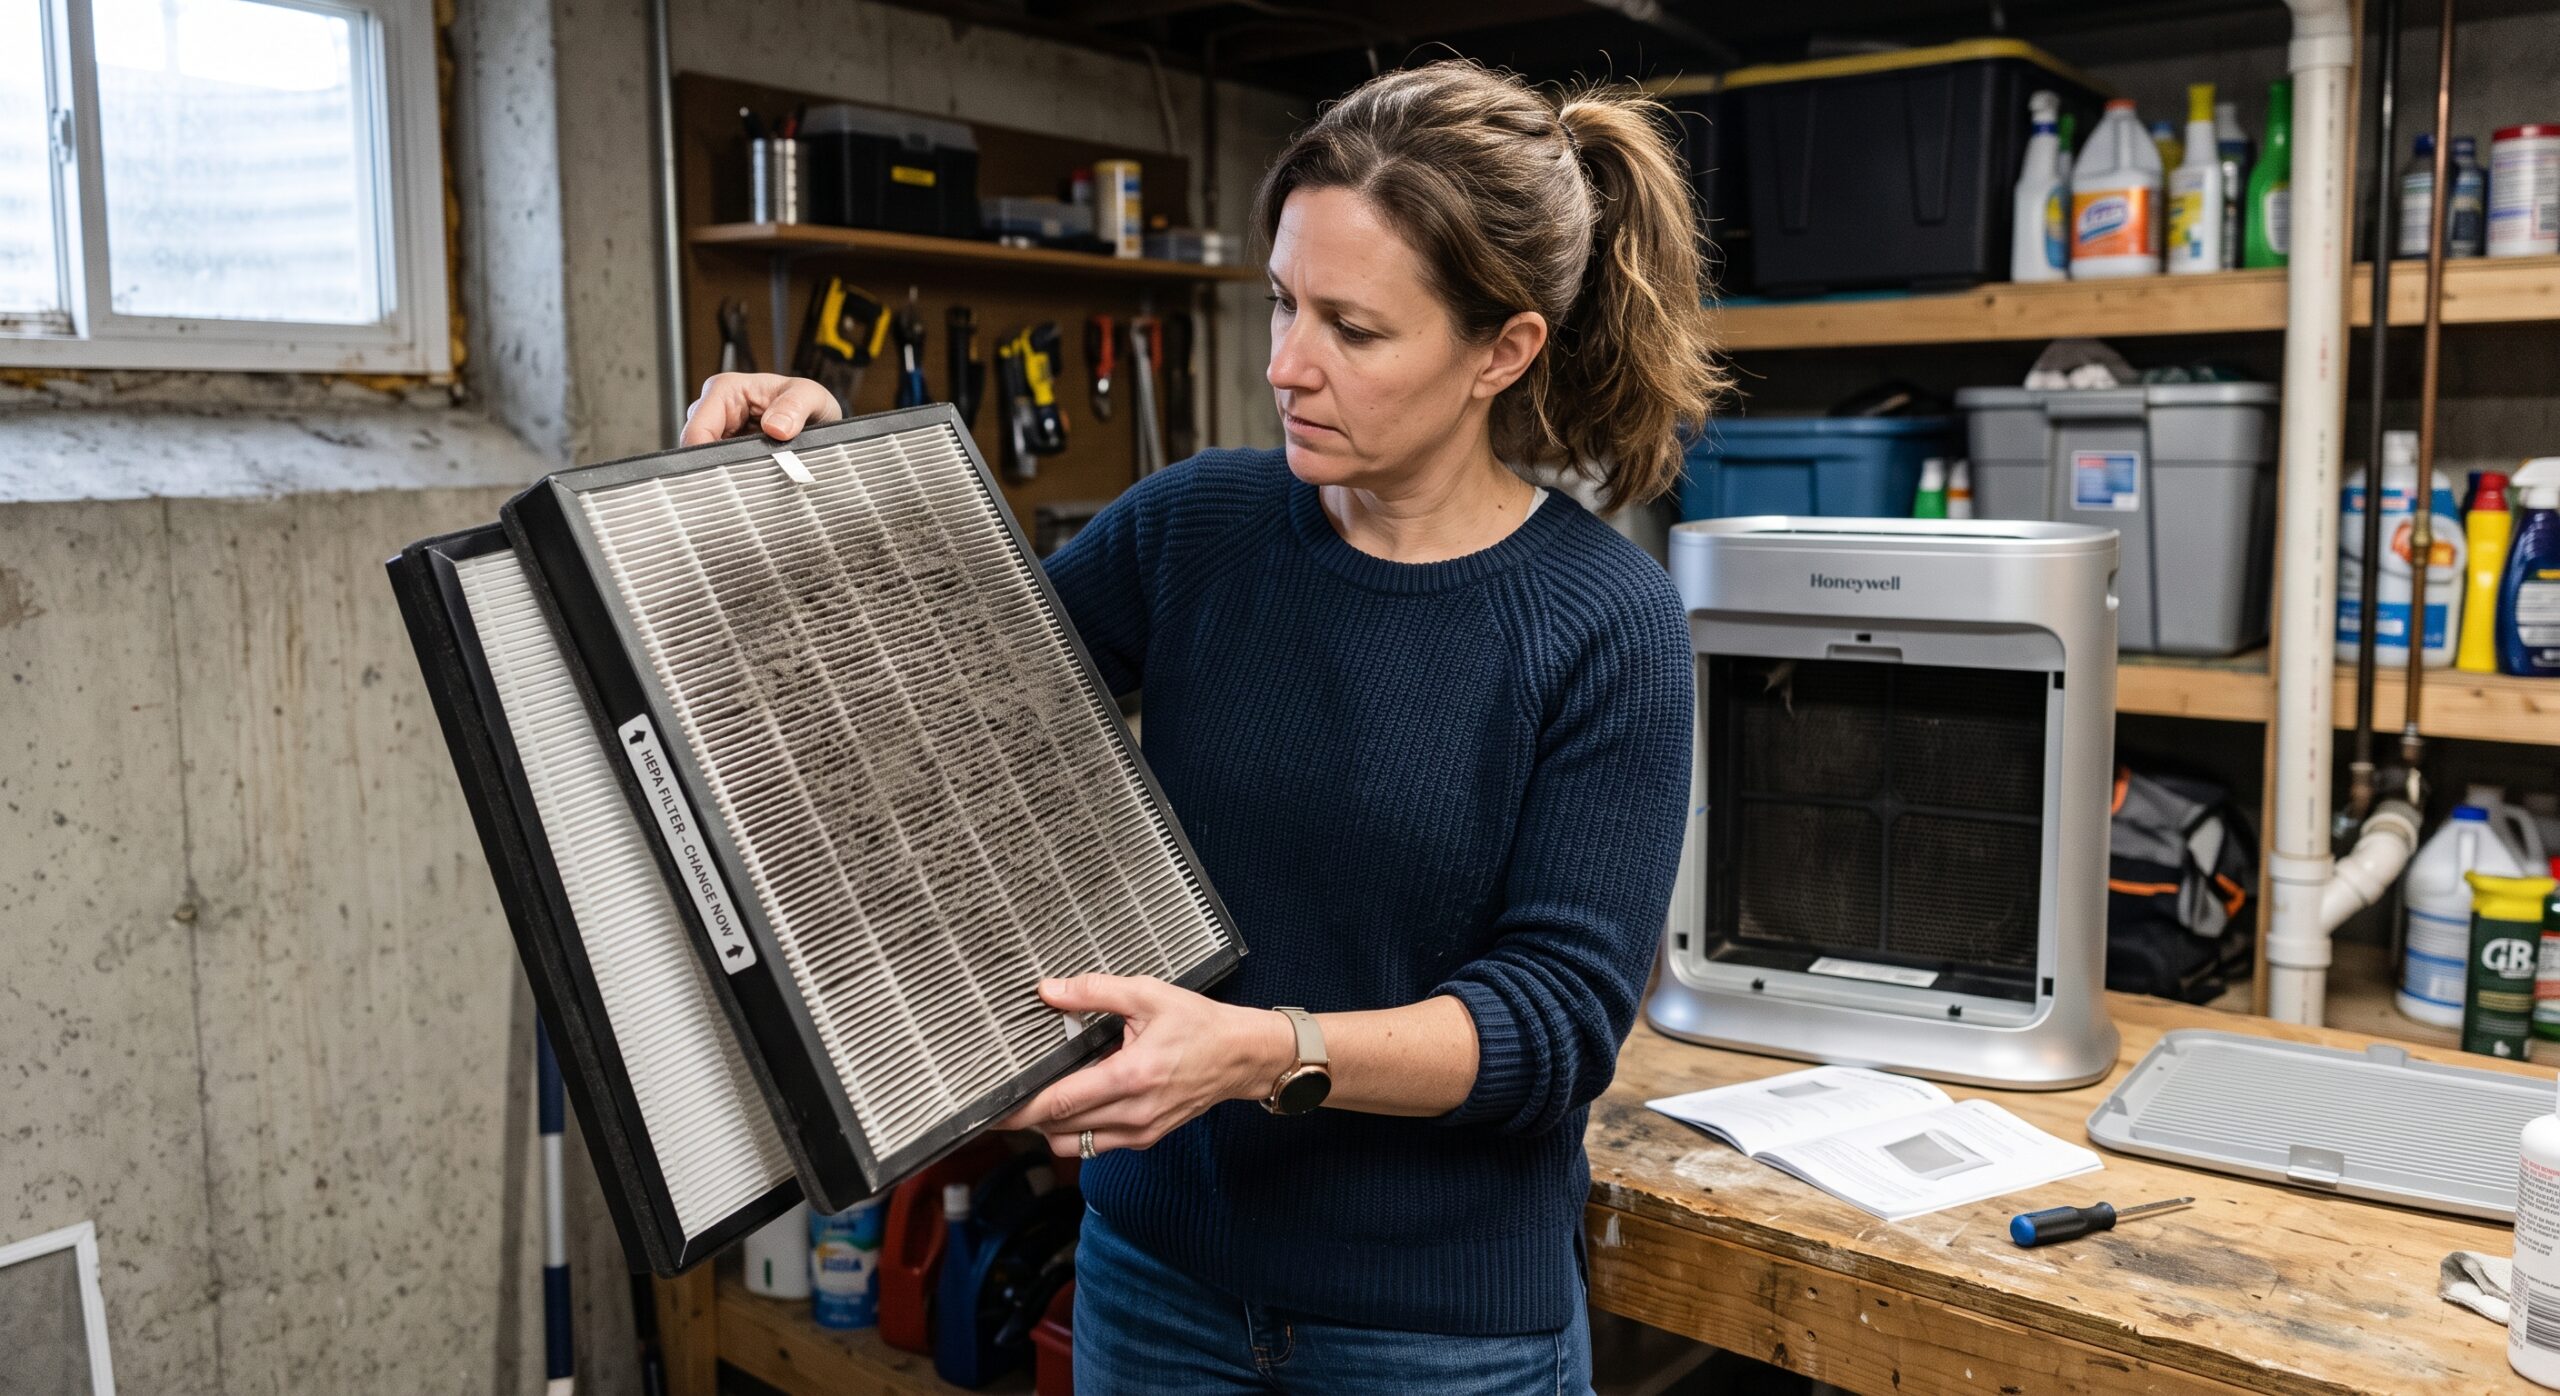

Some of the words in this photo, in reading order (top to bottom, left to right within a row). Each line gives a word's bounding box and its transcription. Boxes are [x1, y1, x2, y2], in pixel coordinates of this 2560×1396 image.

[1810, 573, 1900, 594] Honeywell
[641, 748, 665, 788] HEPA
[658, 786, 686, 835] FILTER
[684, 844, 718, 904] CHANGE
[710, 903, 734, 937] NOW
